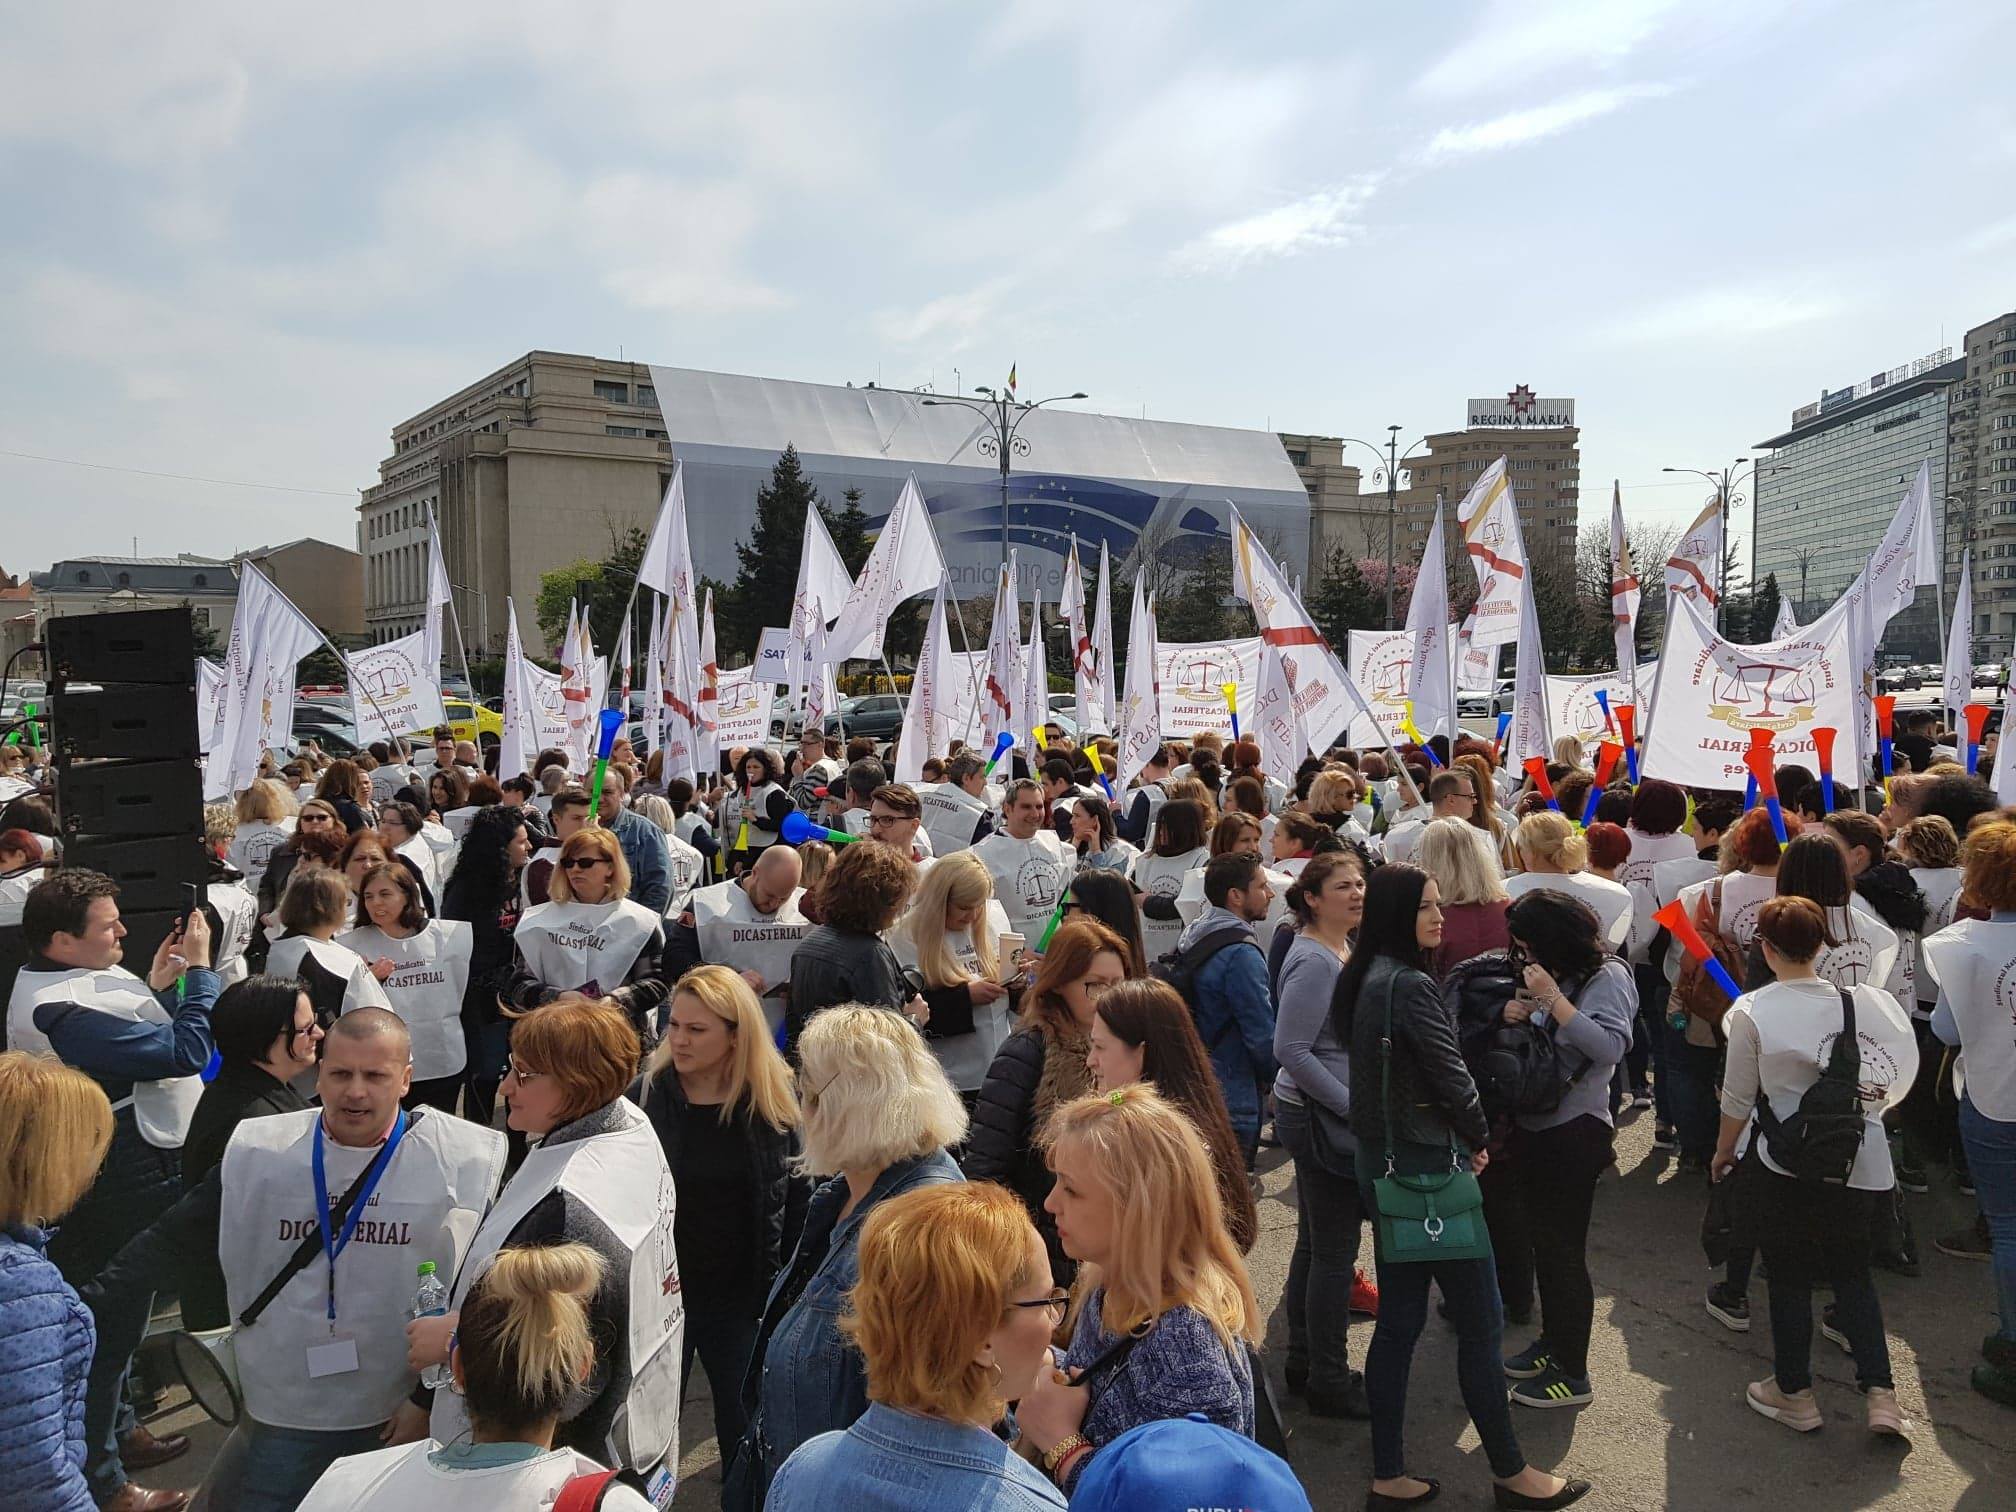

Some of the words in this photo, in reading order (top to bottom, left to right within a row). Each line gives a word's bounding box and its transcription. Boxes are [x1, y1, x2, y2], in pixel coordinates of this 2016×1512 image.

[1472, 414, 1521, 425] REGINA
[1526, 414, 1571, 425] MARIA
[733, 927, 803, 942] DICASTERIAL
[384, 971, 445, 988] ICASTERIAL
[1858, 1031, 1879, 1048] Grefei
[279, 1218, 412, 1246] DICERIAL
